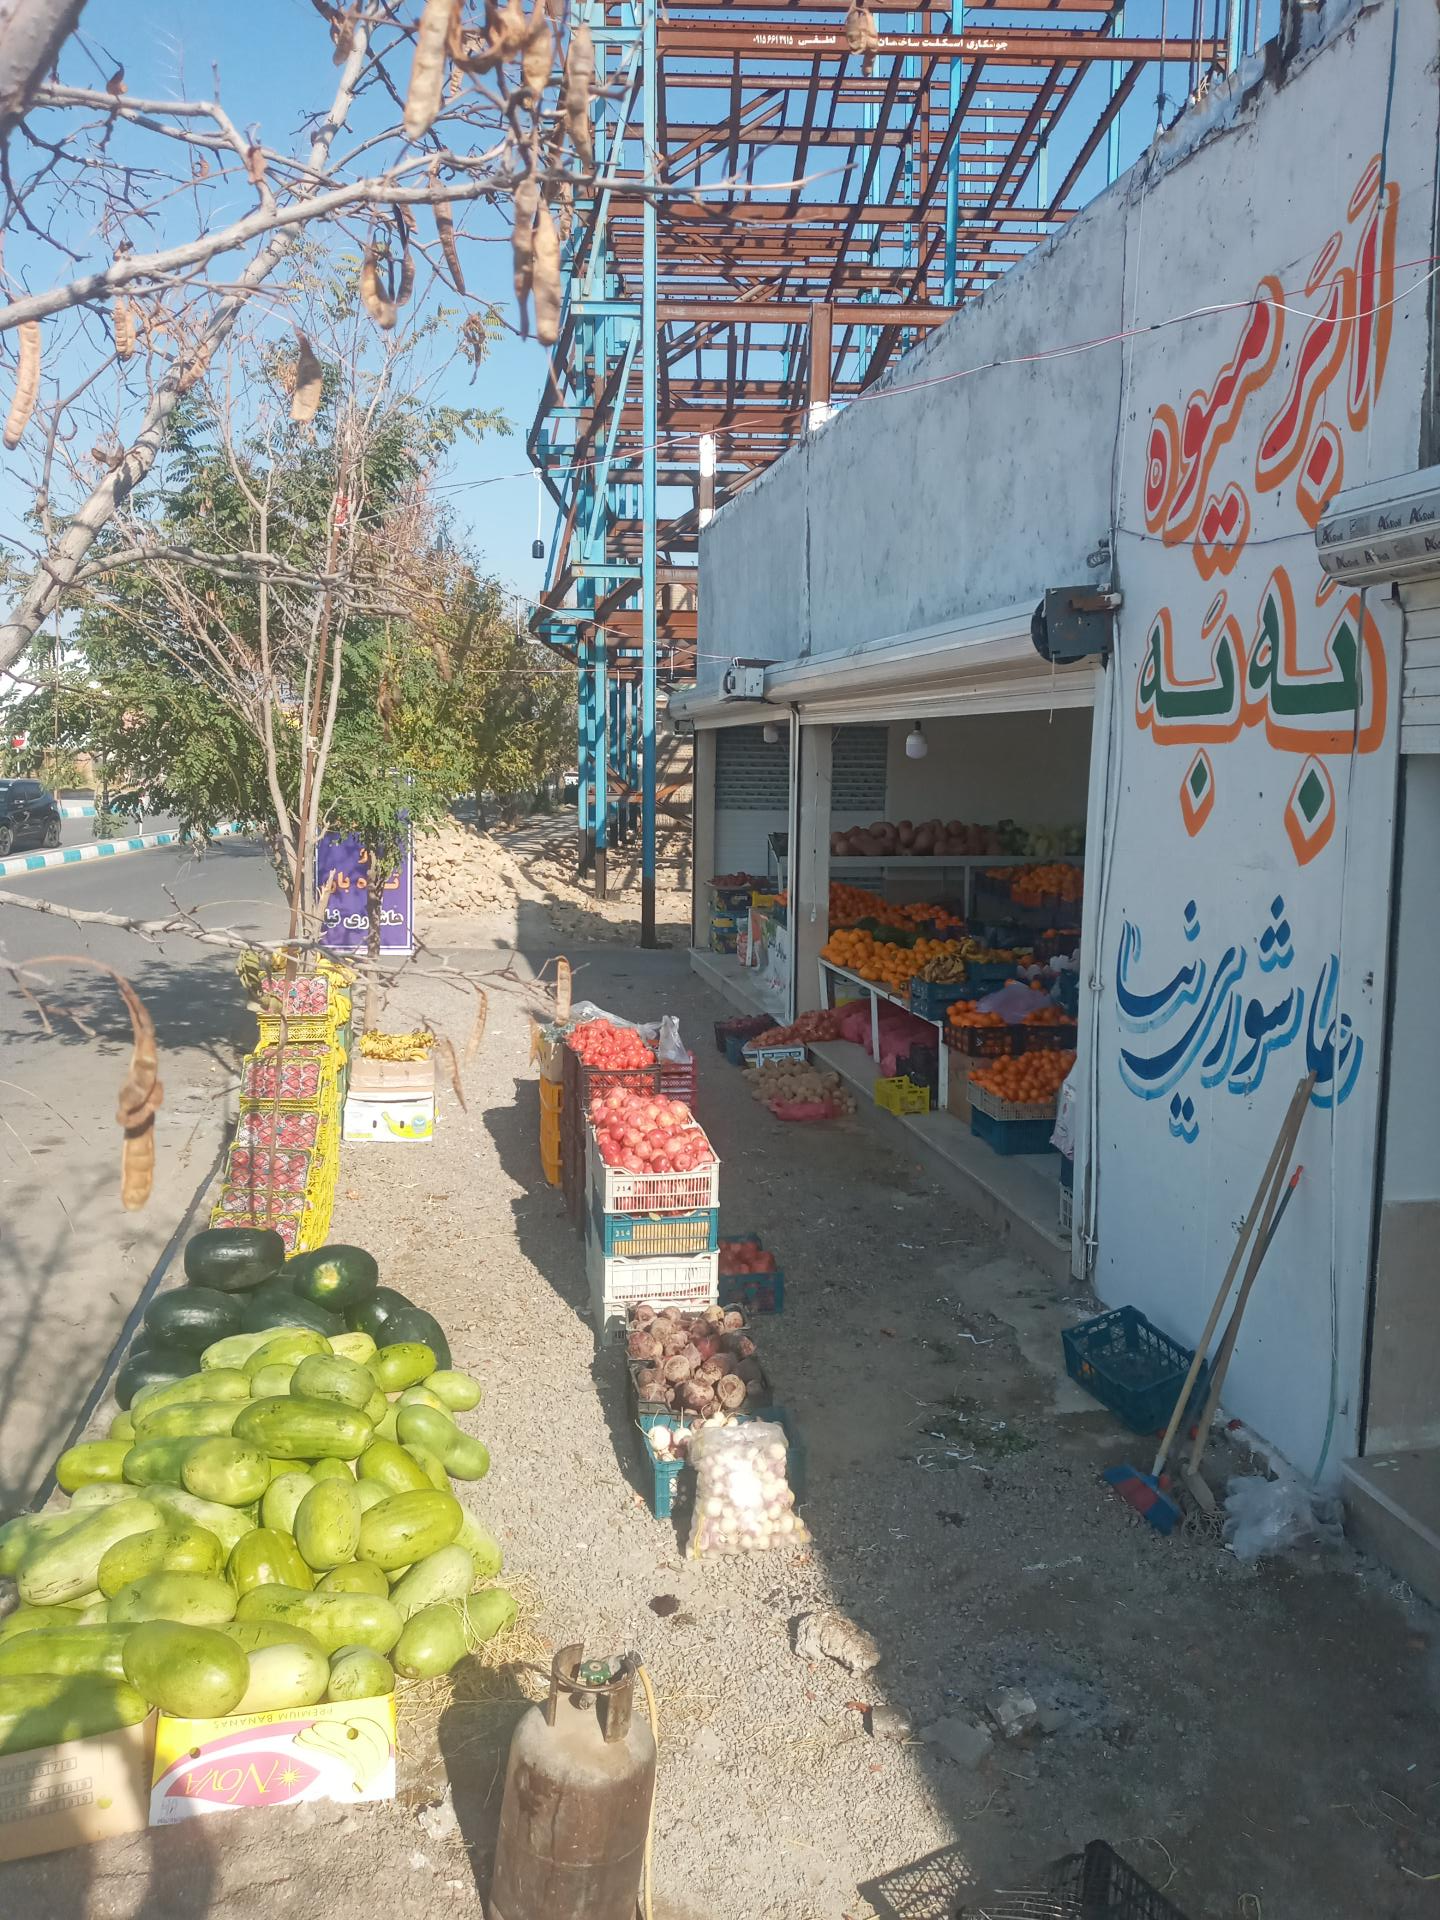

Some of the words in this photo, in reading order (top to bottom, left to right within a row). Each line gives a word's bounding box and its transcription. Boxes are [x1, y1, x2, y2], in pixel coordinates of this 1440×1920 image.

[797, 34, 836, 46] لطفی
[922, 38, 963, 47] اسکلت
[1145, 275, 1285, 580] میوه
[213, 1713, 275, 1729] BANANAS
[277, 1706, 334, 1723] PREMIUM
[185, 1758, 280, 1803] NOVA
